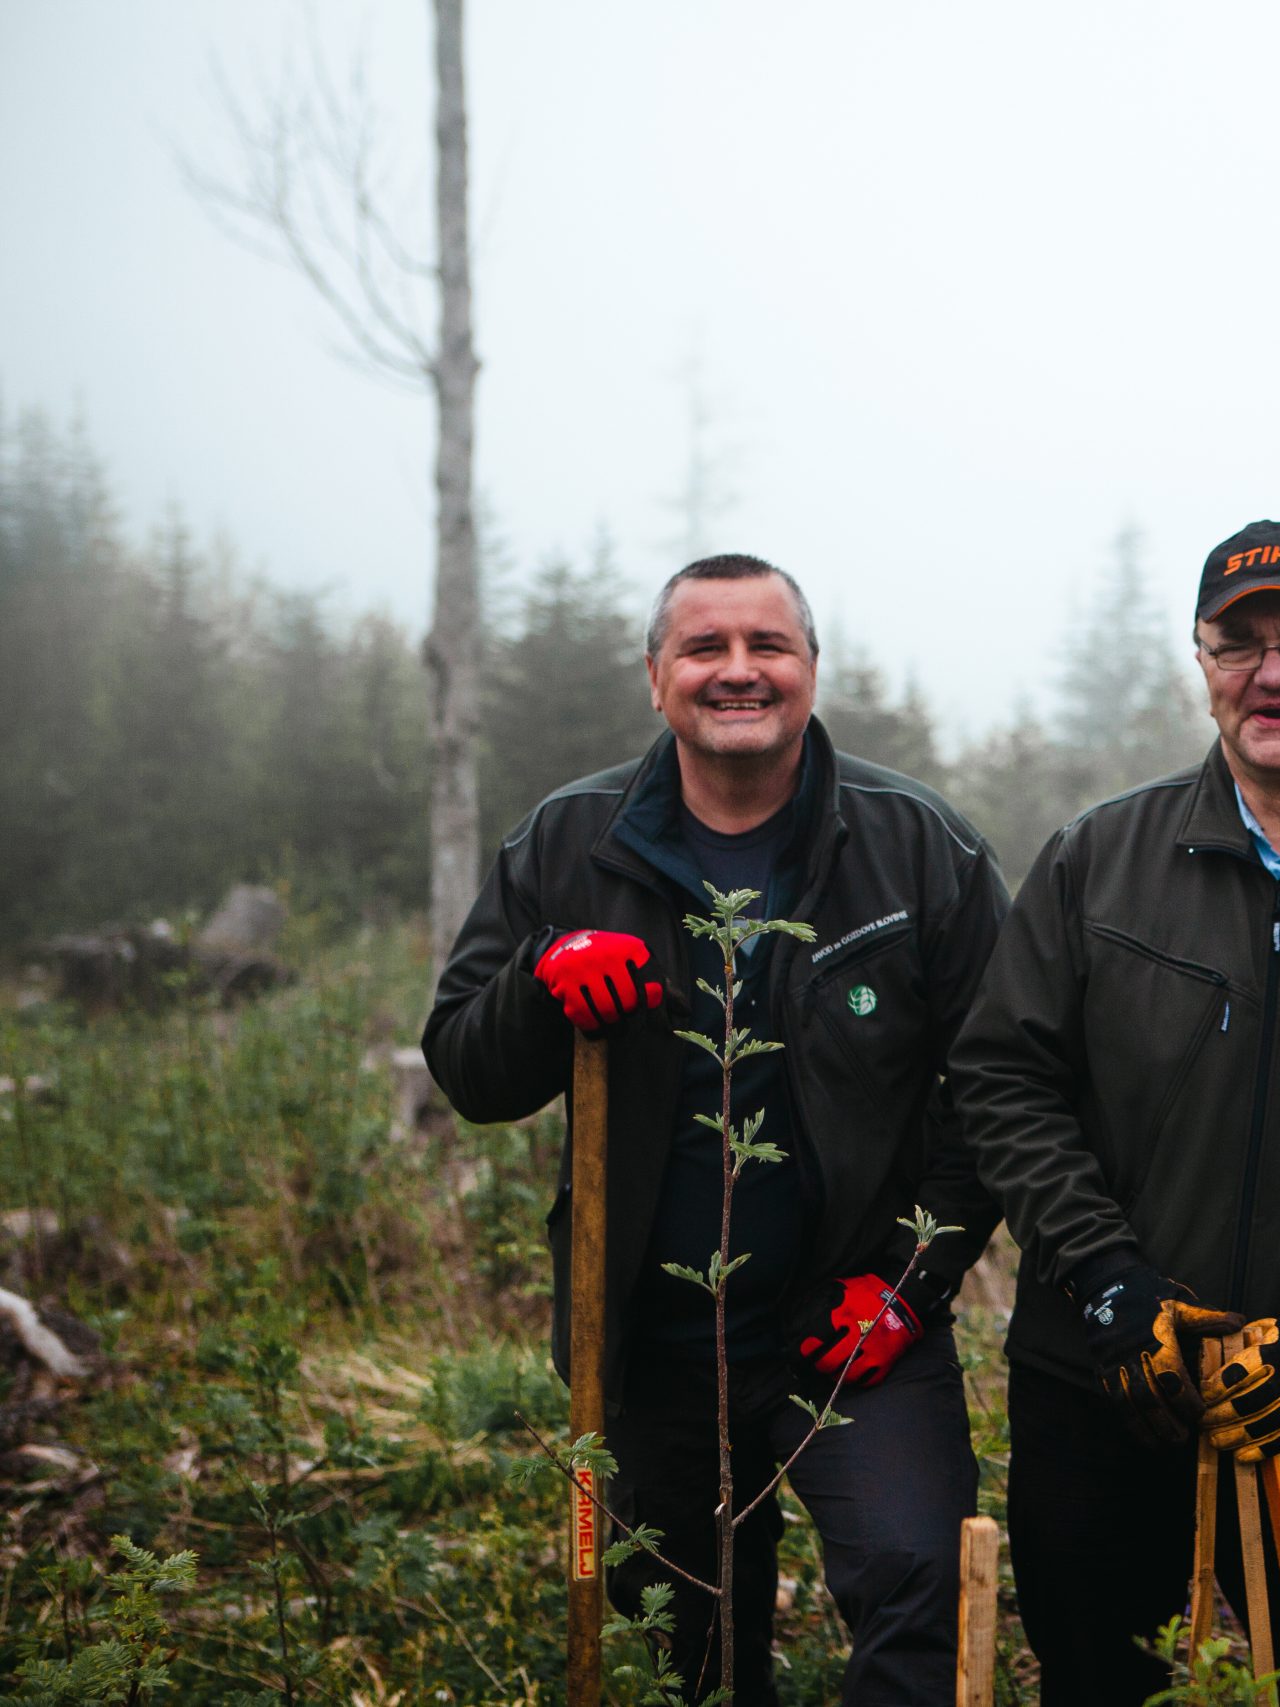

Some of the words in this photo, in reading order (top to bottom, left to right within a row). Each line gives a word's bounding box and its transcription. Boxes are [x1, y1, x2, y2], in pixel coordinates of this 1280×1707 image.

[811, 945, 834, 964] ZAVOD
[841, 922, 877, 945] GOZDOVE
[578, 1471, 594, 1576] KRMELJ
